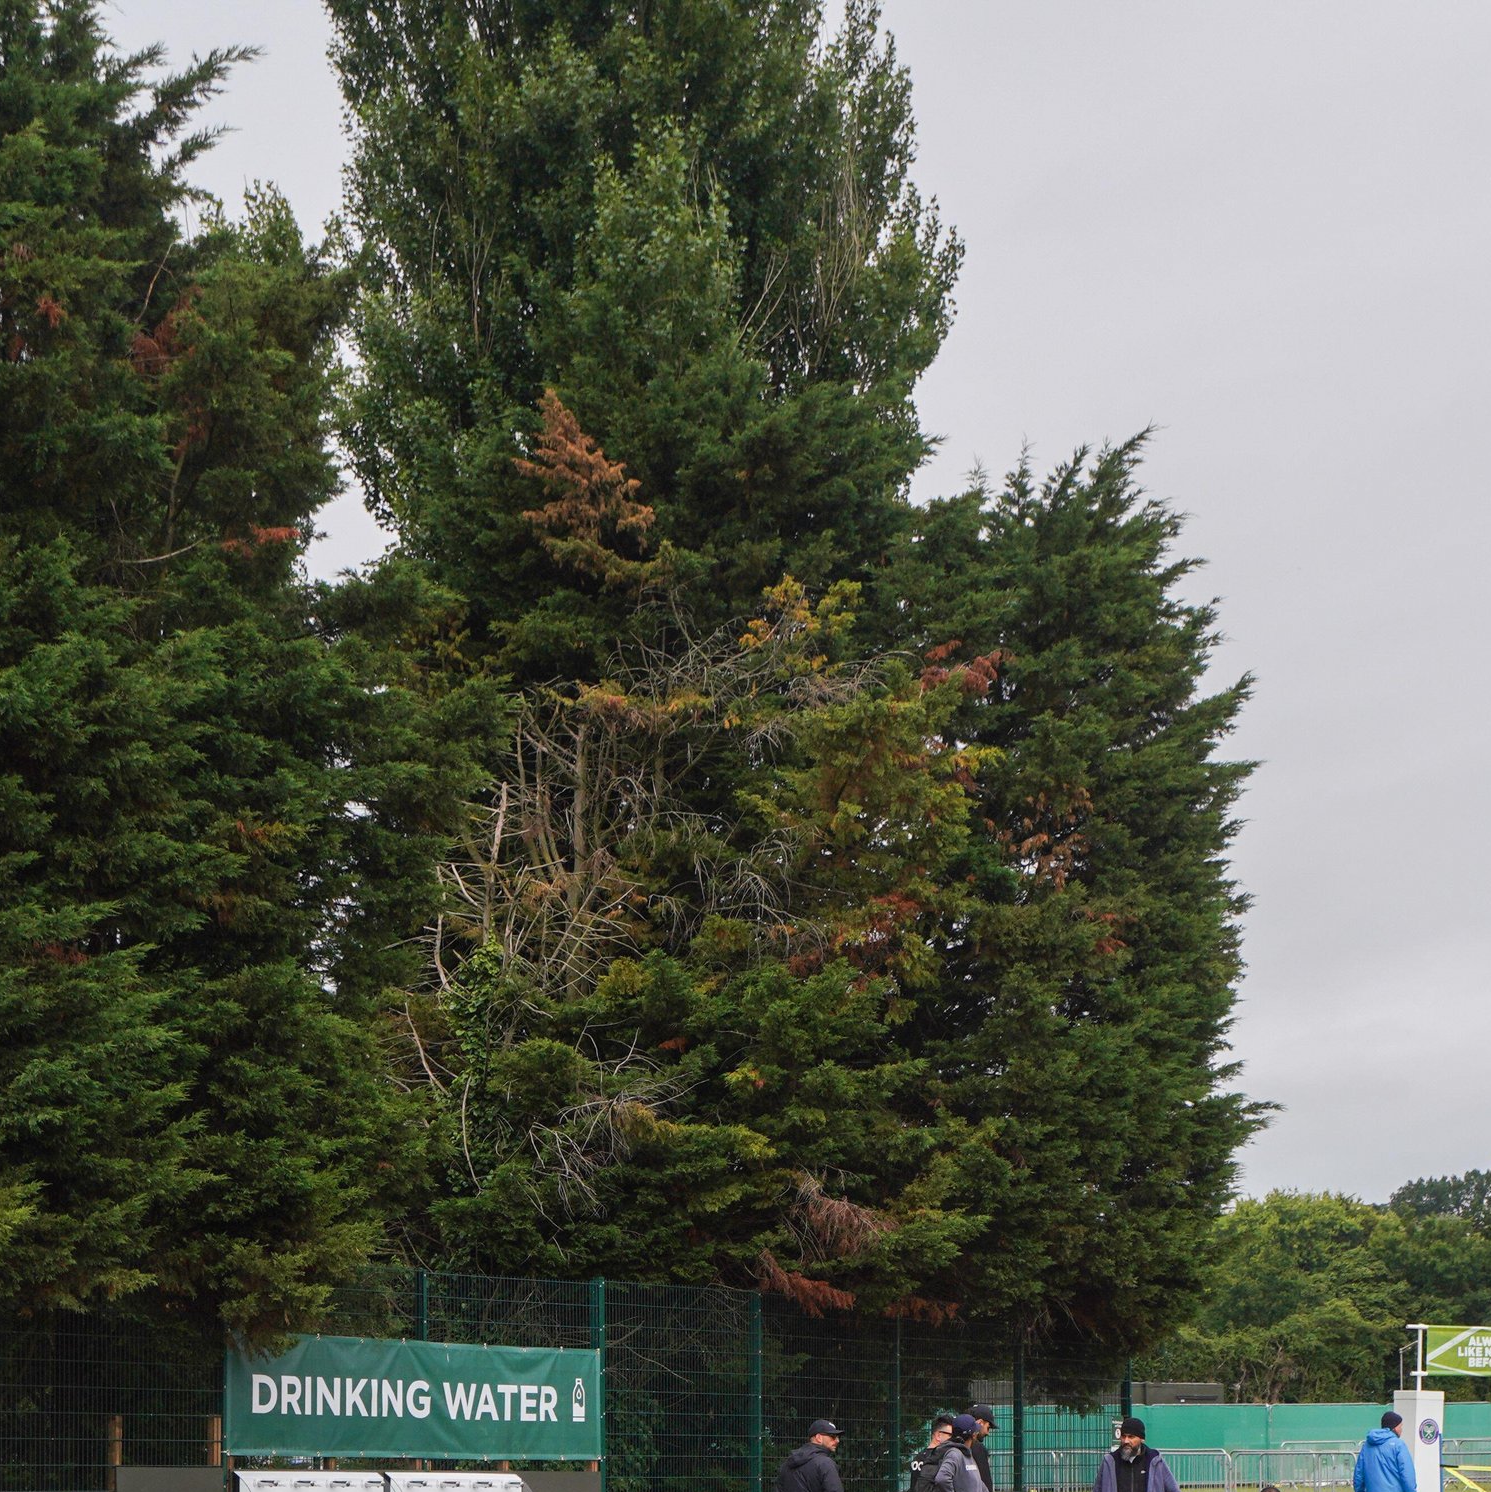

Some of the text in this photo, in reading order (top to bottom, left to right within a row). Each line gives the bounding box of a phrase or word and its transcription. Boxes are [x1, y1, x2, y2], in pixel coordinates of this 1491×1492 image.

[1457, 1347, 1482, 1357] LIKE
[251, 1374, 558, 1422] DRINKING WATER
